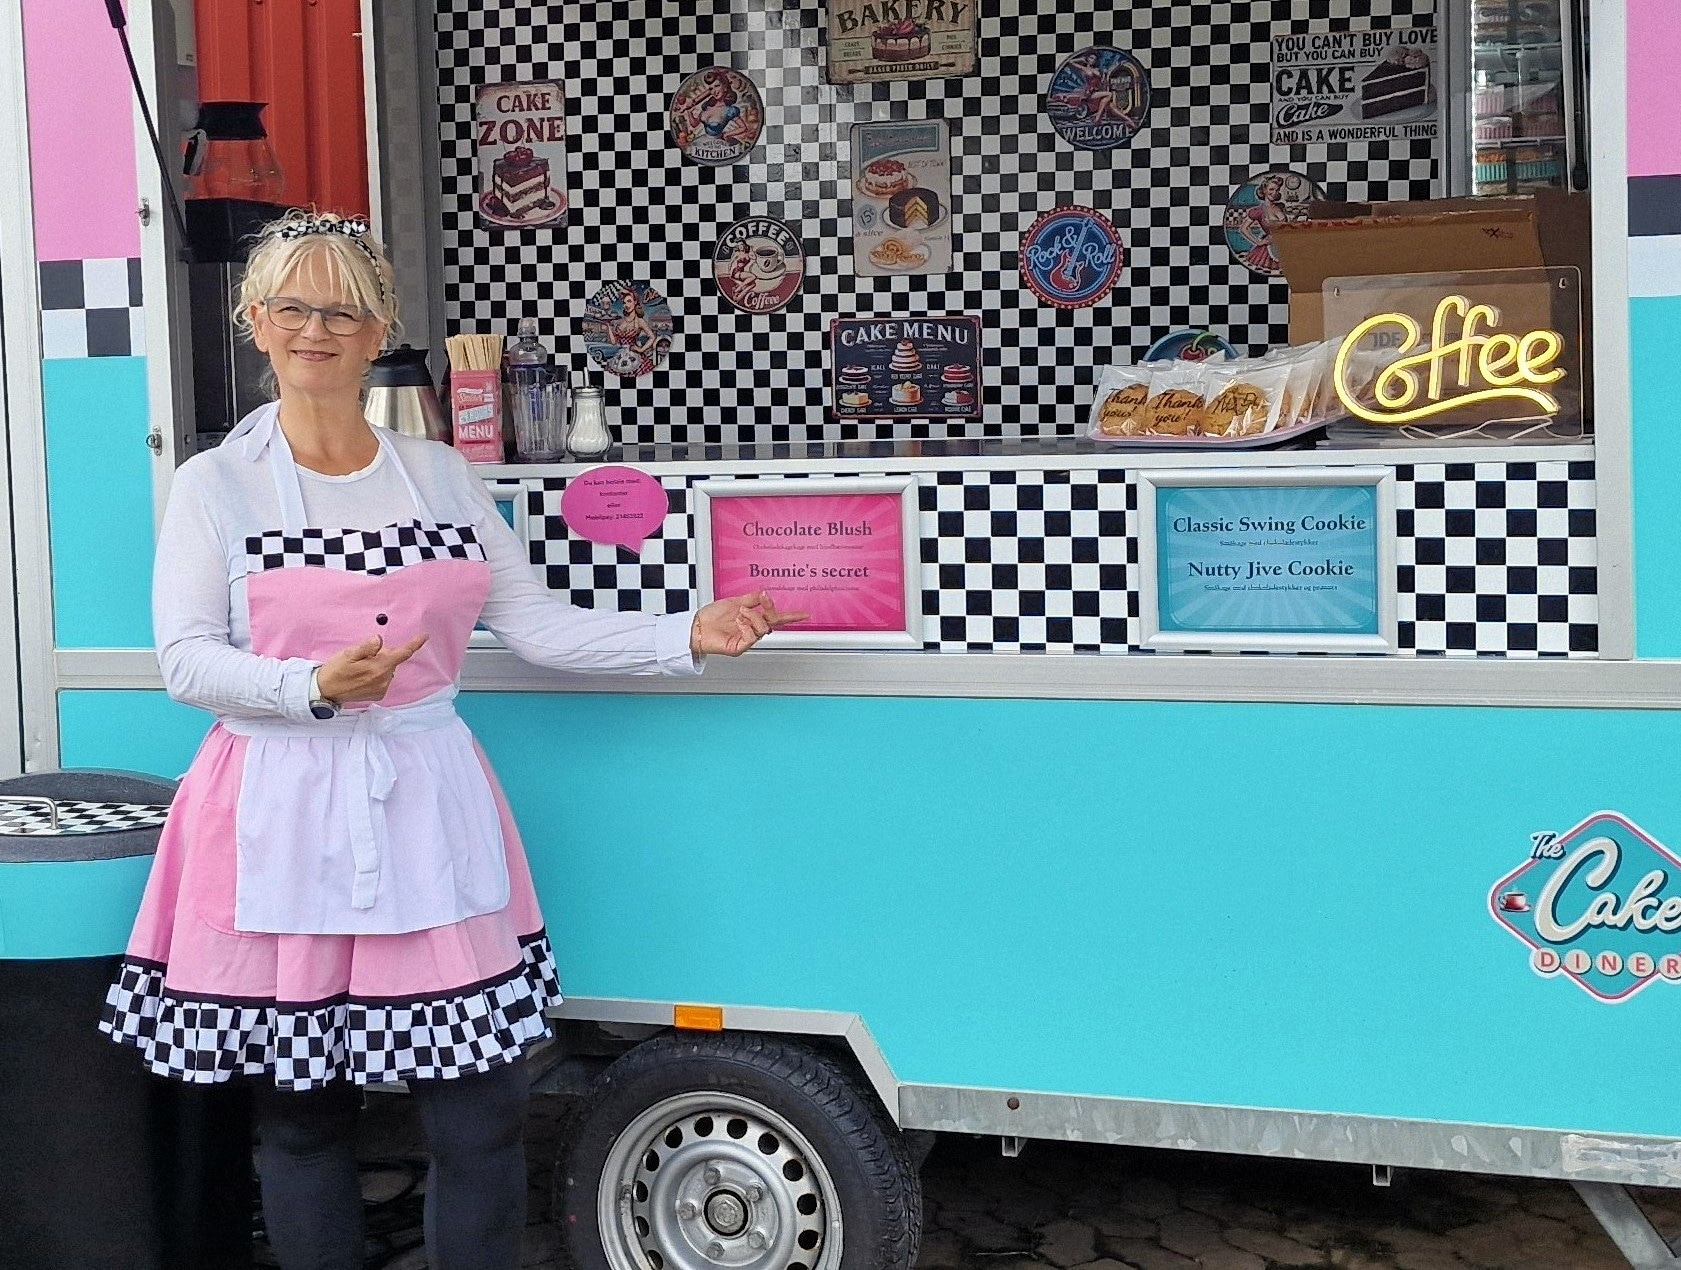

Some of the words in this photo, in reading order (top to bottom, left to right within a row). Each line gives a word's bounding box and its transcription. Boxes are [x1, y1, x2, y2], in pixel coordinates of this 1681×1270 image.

[836, 0, 968, 33] BAKERY
[1275, 36, 1306, 51] YOU
[1311, 33, 1357, 50] CAN'T
[1362, 31, 1393, 46] BUY
[1398, 28, 1437, 45] LOVE
[1277, 50, 1300, 63] BUT
[1304, 50, 1327, 61] YOU
[1332, 49, 1355, 60] CAN
[1360, 47, 1383, 58] BUY
[1275, 66, 1355, 97] CAKE
[497, 92, 552, 114] CAKE
[1278, 102, 1329, 125] Cake
[478, 116, 564, 146] ZONE
[1275, 130, 1299, 143] AND
[1302, 129, 1312, 141] IS
[1316, 129, 1324, 141] A
[1328, 126, 1399, 140] WONDERFUL
[1403, 124, 1438, 138] THING
[694, 147, 736, 159] KITCHEN
[726, 222, 790, 248] COFFEE
[1026, 235, 1063, 270] Rock
[1062, 226, 1078, 248] &
[1082, 242, 1117, 271] Roll
[841, 322, 898, 347] CAKE
[903, 321, 968, 345] MENU
[1333, 294, 1568, 424] Coffee
[1154, 410, 1189, 428] you!
[458, 425, 494, 440] MENU
[743, 520, 822, 537] Chocolate
[827, 520, 872, 537] Blush
[1173, 517, 1234, 533] Classic
[1238, 516, 1296, 535] Swing
[1301, 514, 1367, 531] Cookie
[749, 563, 817, 578] Bonnie's
[821, 566, 869, 578] secret
[1187, 561, 1241, 580] Nutty
[1246, 560, 1283, 580] Jive
[1288, 558, 1354, 576] Cookie
[1532, 833, 1566, 859] The
[1534, 837, 1681, 945] Cake
[1540, 951, 1681, 976] DINER
